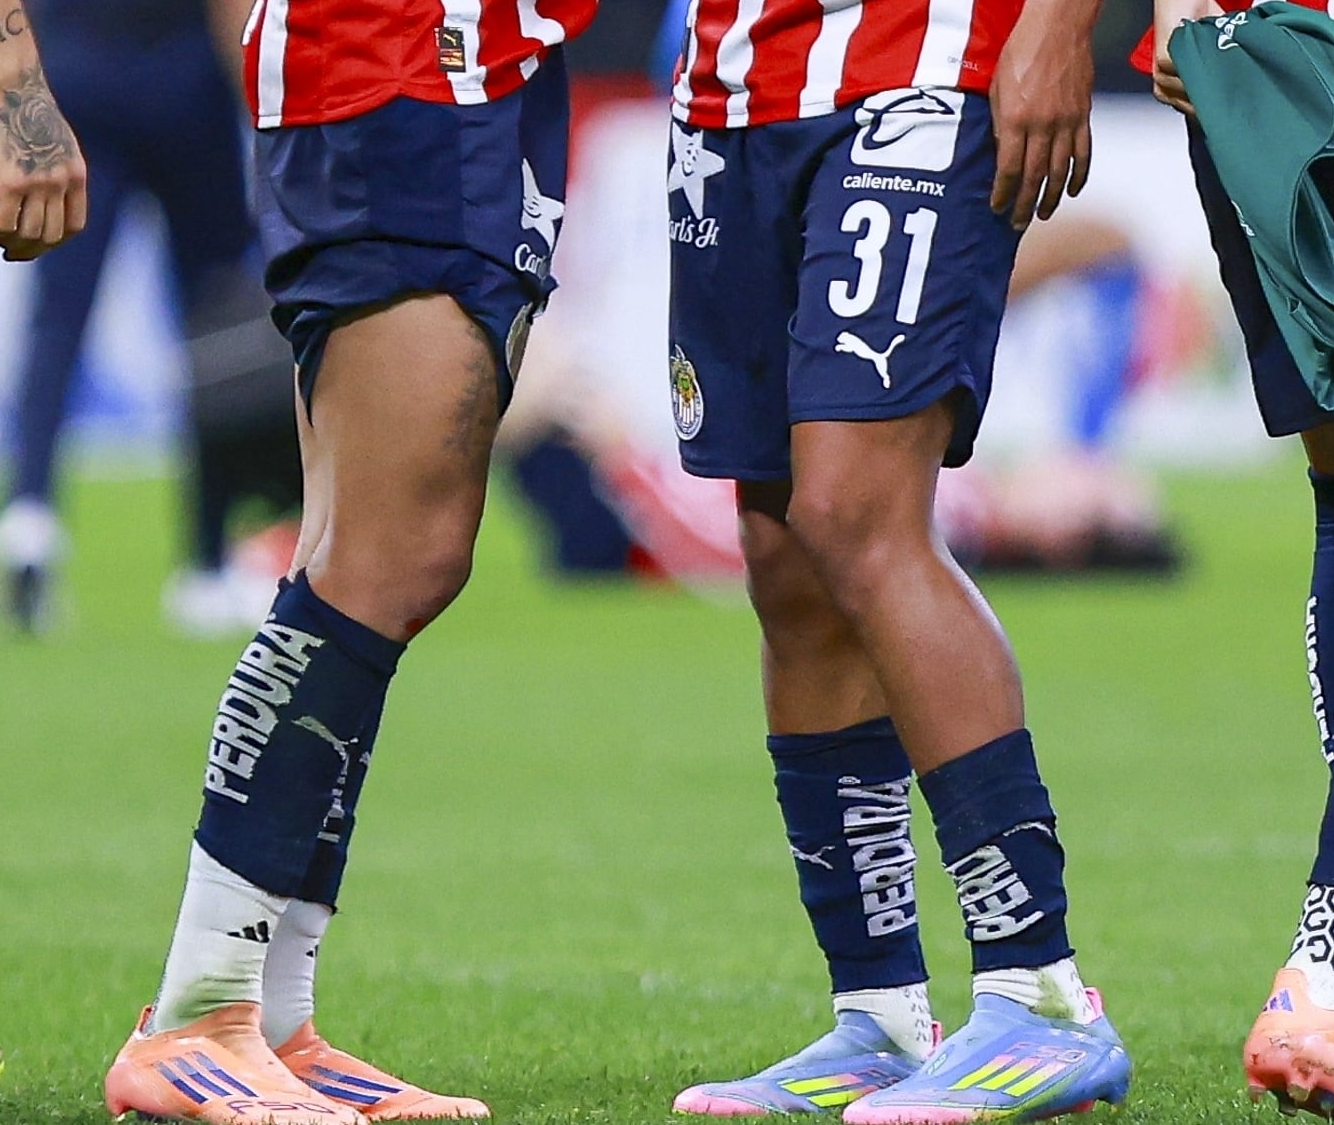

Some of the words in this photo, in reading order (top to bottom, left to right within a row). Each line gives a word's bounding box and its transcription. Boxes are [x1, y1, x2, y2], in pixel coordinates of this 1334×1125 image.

[843, 173, 946, 197] caliente.mx
[668, 212, 694, 244] arl's
[827, 199, 939, 325] 31
[205, 623, 326, 805] PERDURA
